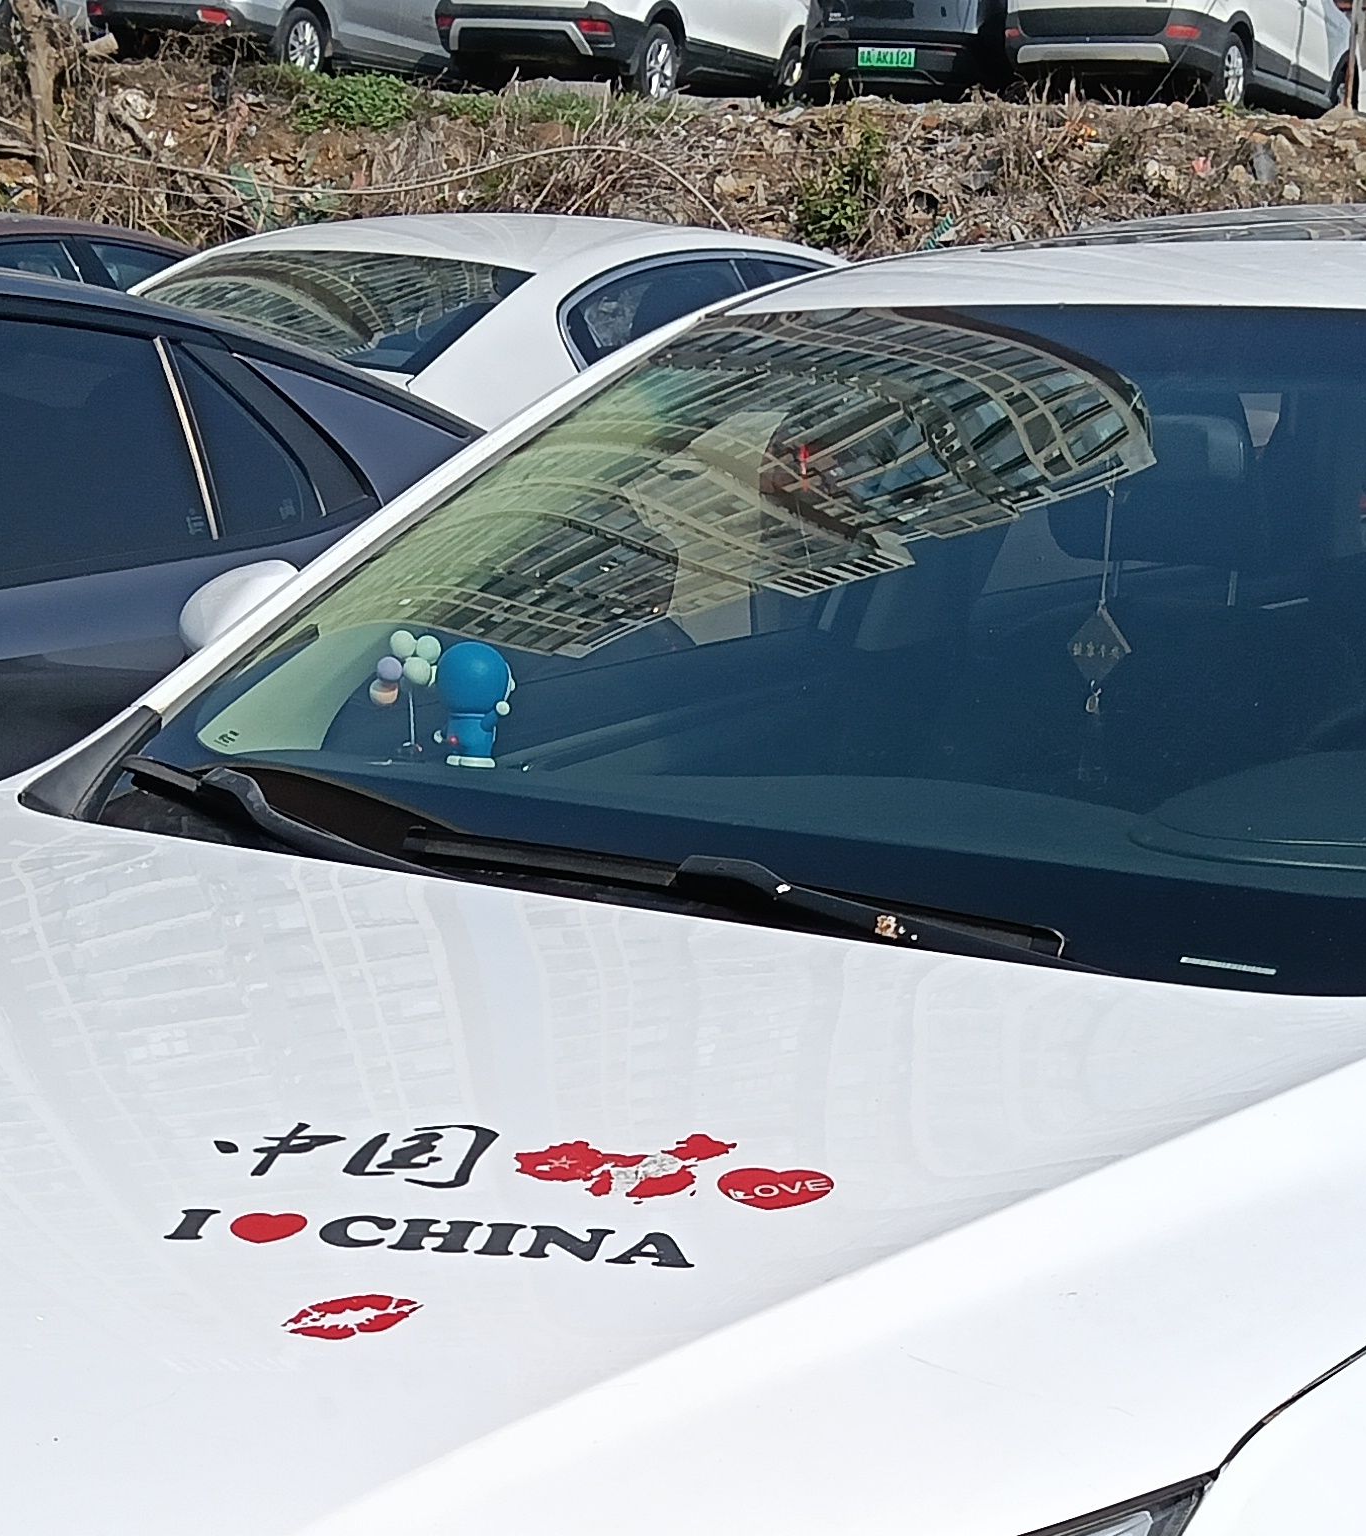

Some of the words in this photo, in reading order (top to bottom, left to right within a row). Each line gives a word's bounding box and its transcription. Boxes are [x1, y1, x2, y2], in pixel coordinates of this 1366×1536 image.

[213, 1122, 499, 1189] 中国
[728, 1174, 834, 1201] LOVE
[319, 1215, 695, 1269] CHINA
